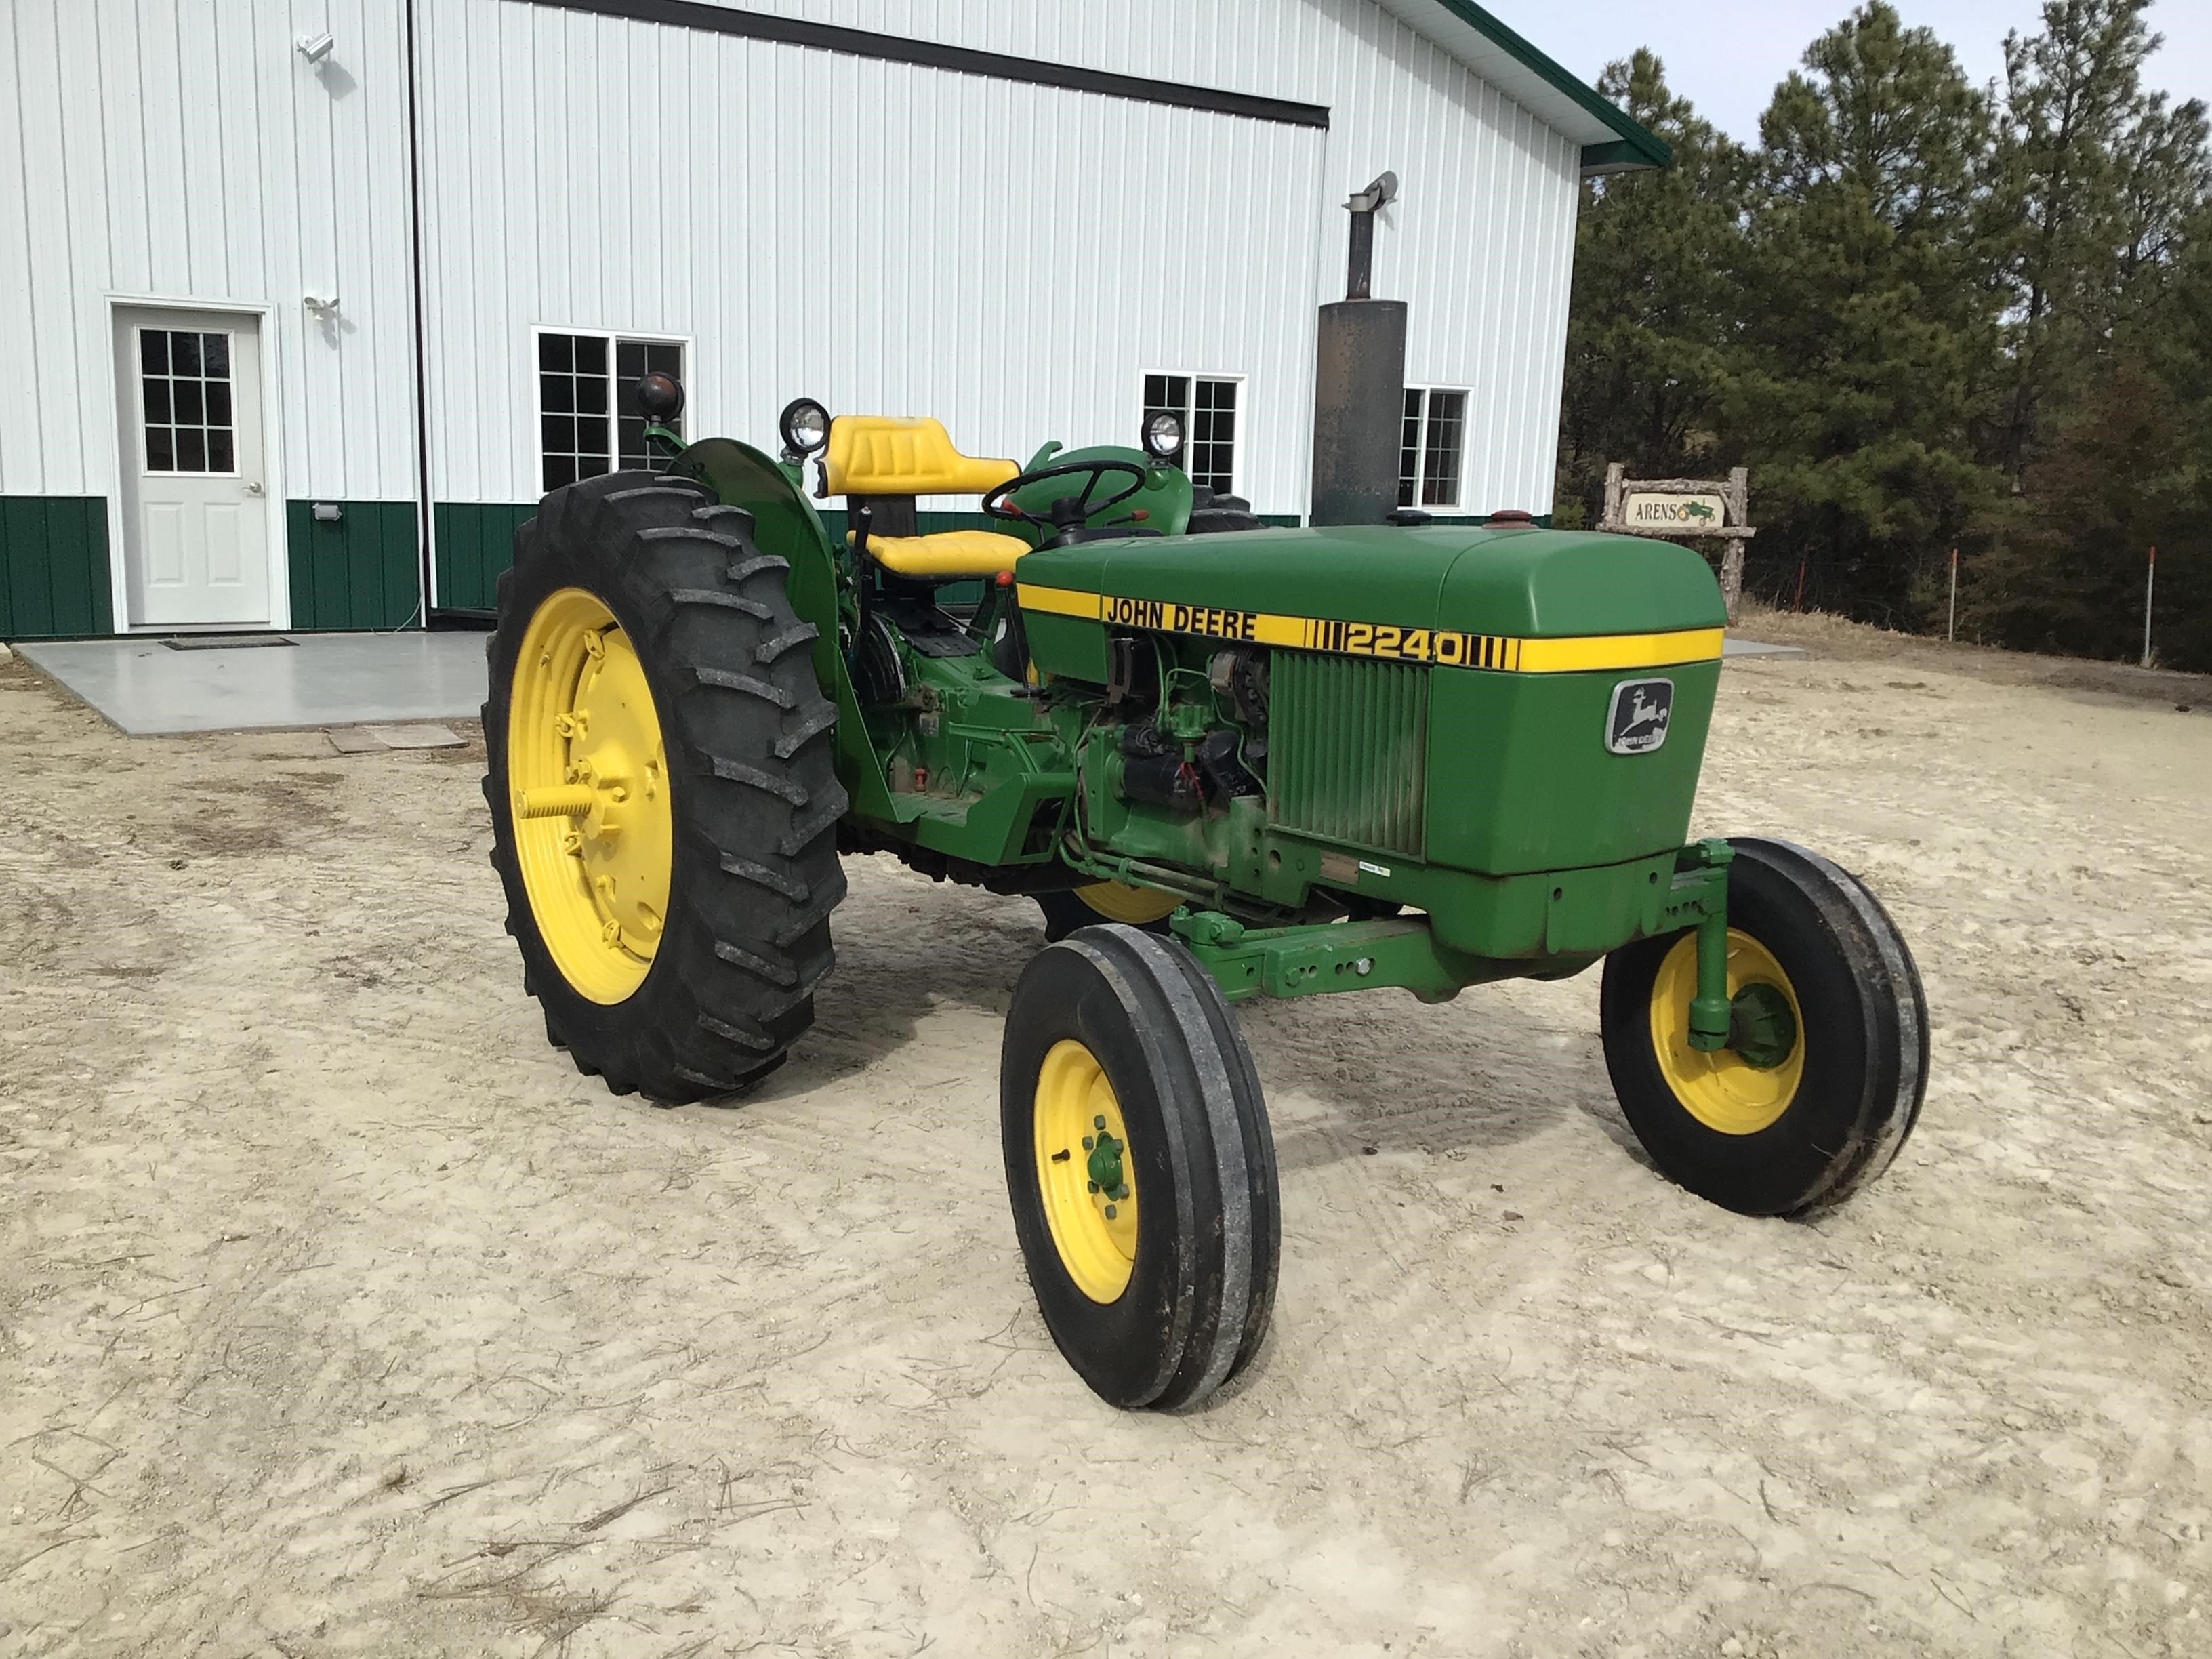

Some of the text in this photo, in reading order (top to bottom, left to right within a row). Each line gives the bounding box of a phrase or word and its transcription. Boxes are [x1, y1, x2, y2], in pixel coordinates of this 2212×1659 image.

[1636, 504, 1677, 520] ARENS
[1107, 597, 1257, 640] JOHN DEERE
[1347, 623, 1464, 665] 2240
